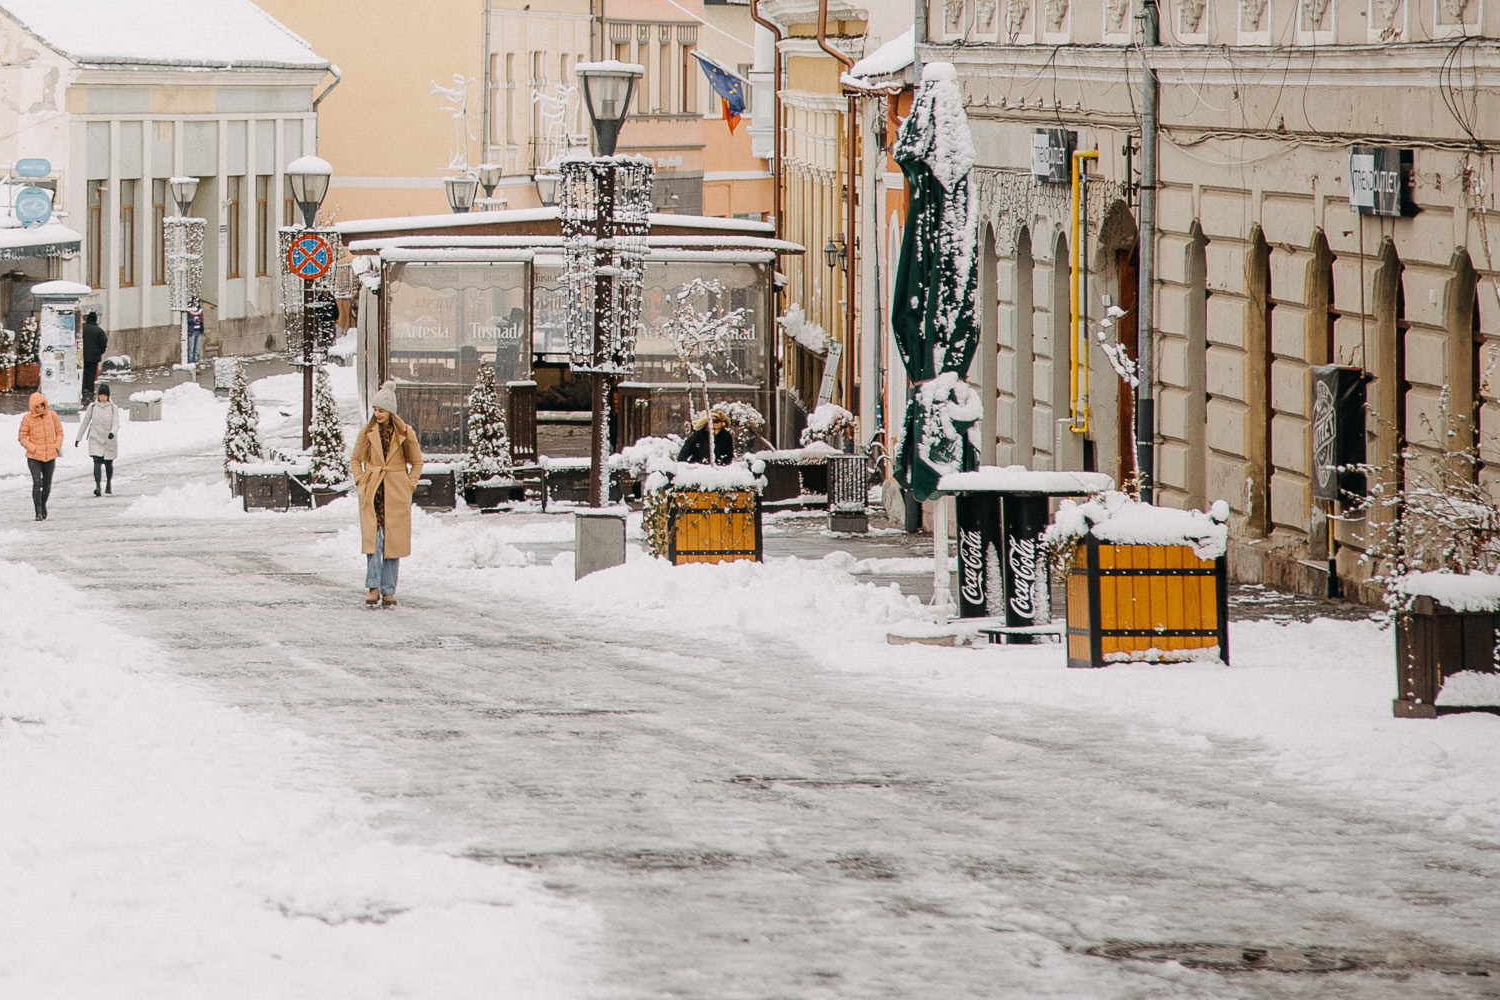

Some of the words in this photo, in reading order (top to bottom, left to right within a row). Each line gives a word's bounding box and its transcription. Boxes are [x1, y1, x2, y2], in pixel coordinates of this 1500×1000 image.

[400, 321, 450, 339] Artesia
[960, 527, 984, 605] Coca-Cola
[1009, 534, 1036, 619] Coca-Cola
